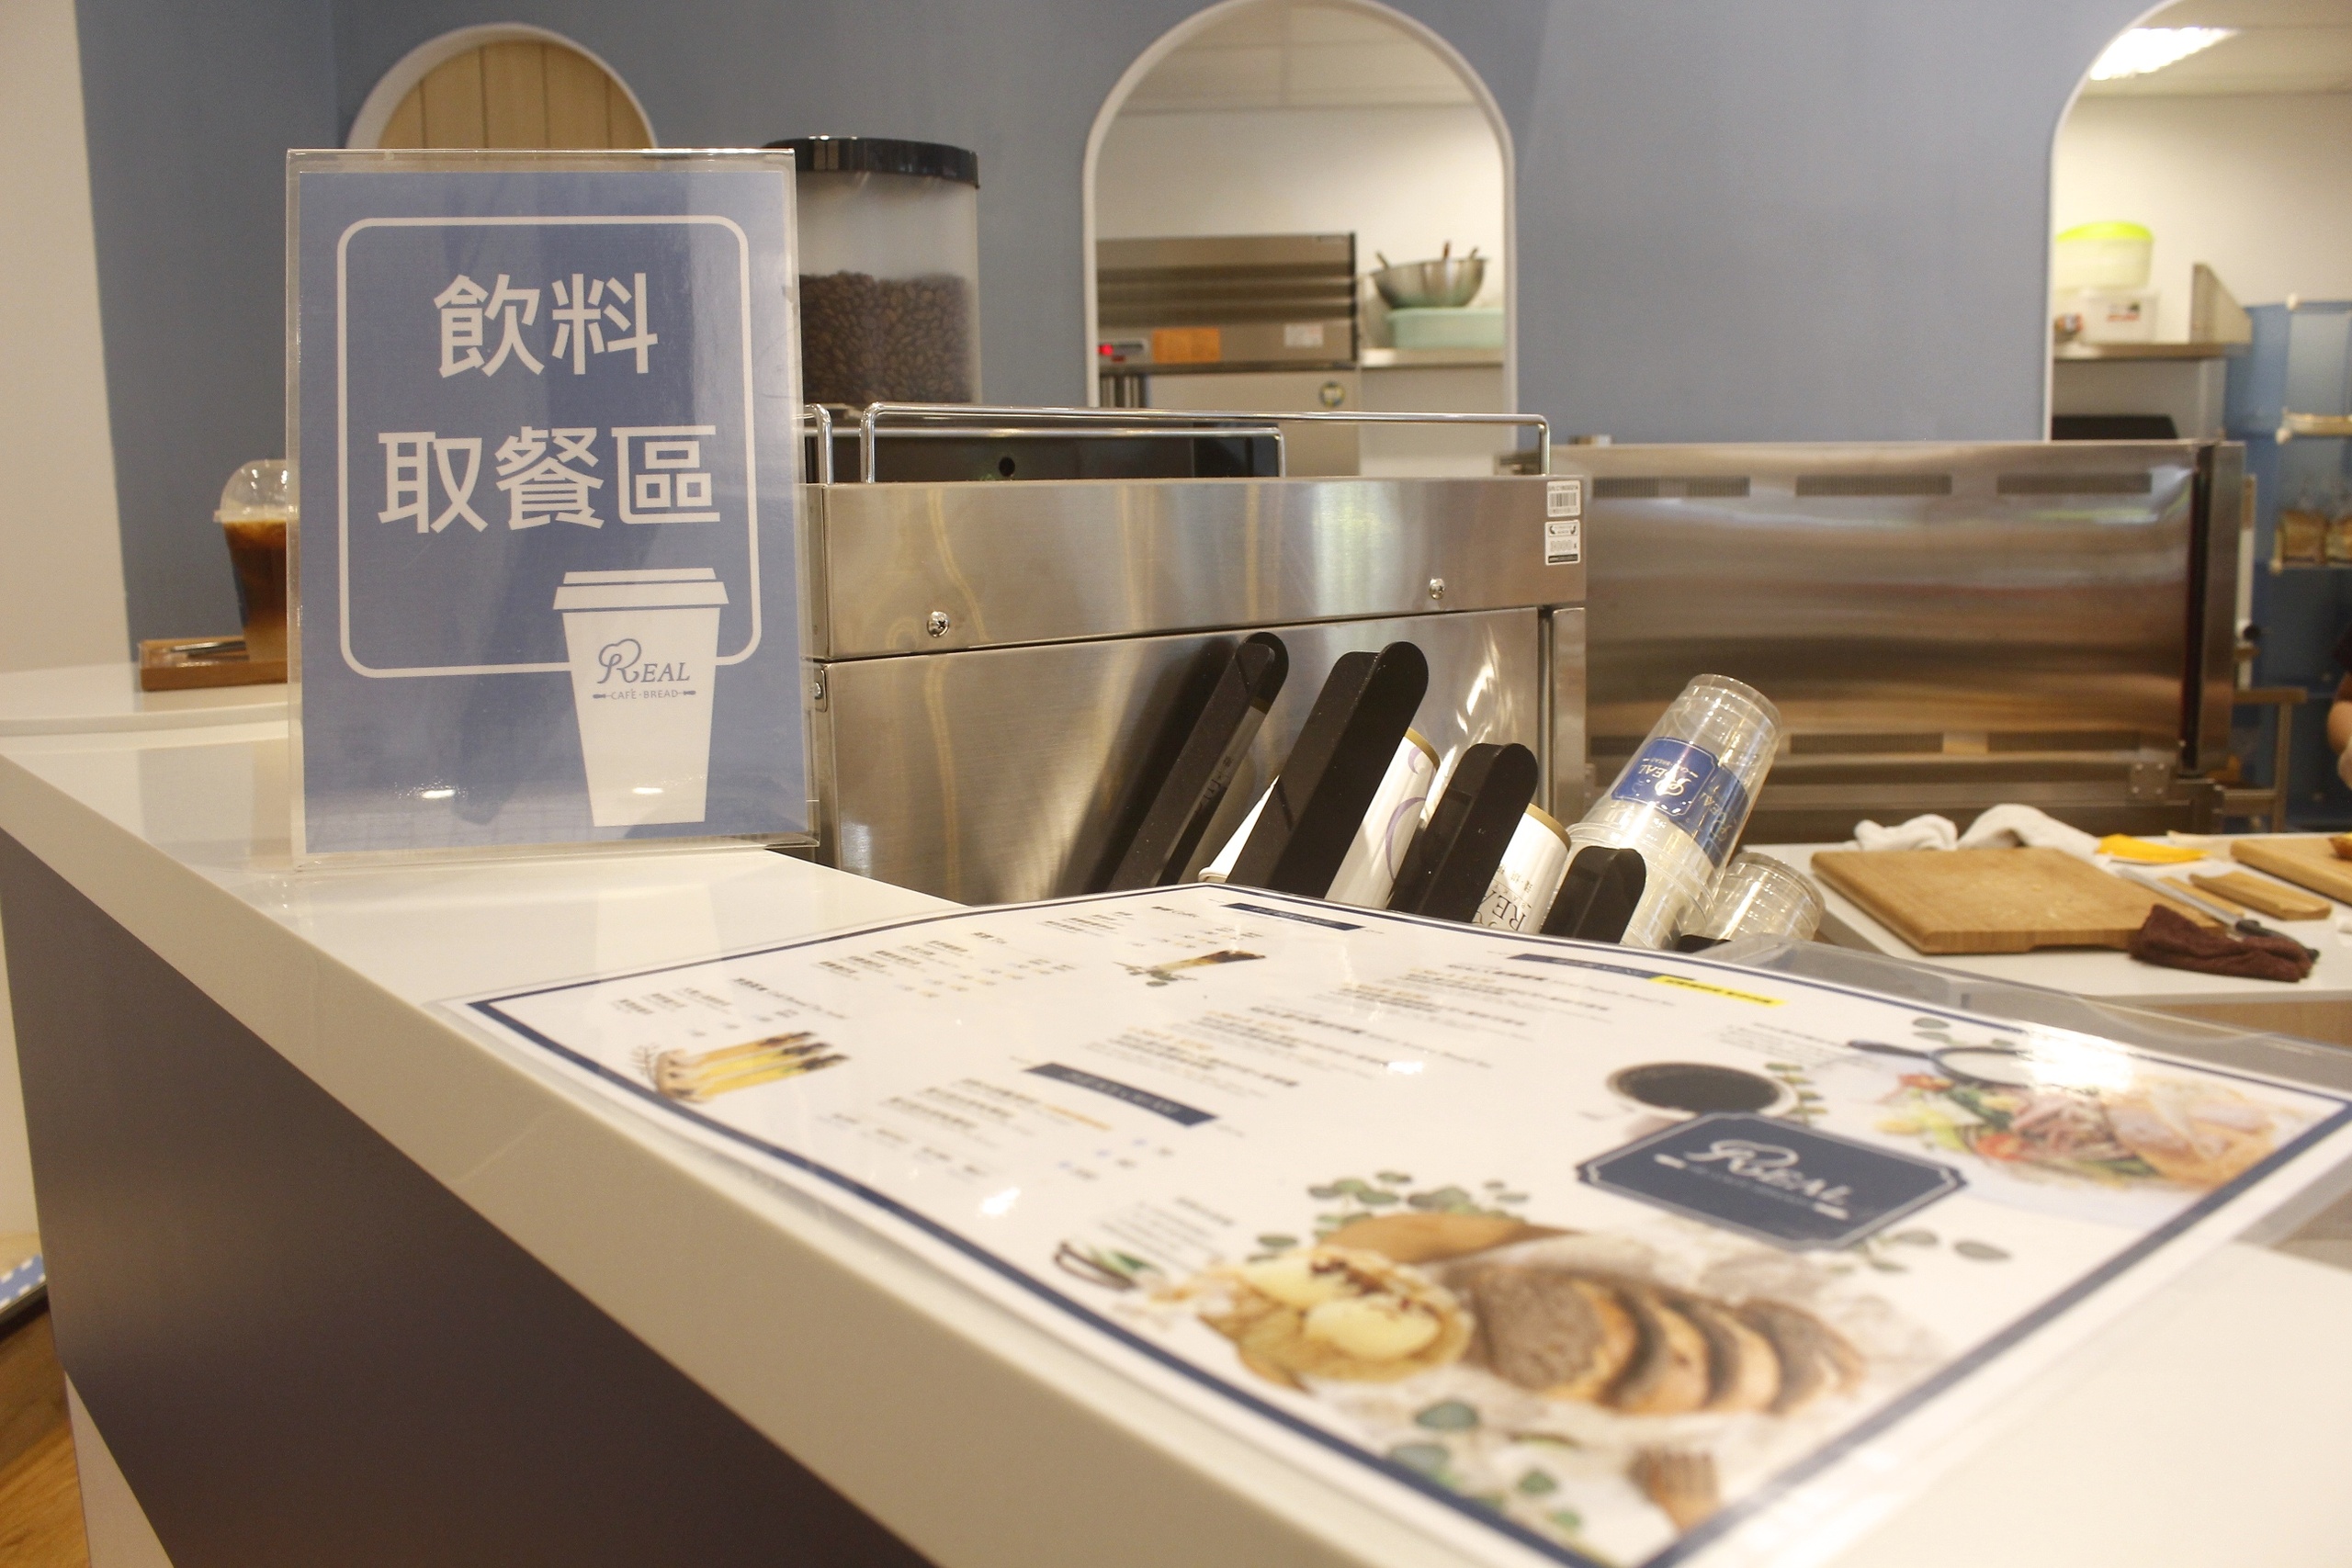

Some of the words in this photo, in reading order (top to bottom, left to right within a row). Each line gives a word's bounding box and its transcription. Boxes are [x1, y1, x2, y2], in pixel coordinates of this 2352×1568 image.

[434, 272, 659, 378] 飲料
[378, 424, 721, 535] 取餐區
[597, 638, 690, 683] REAL
